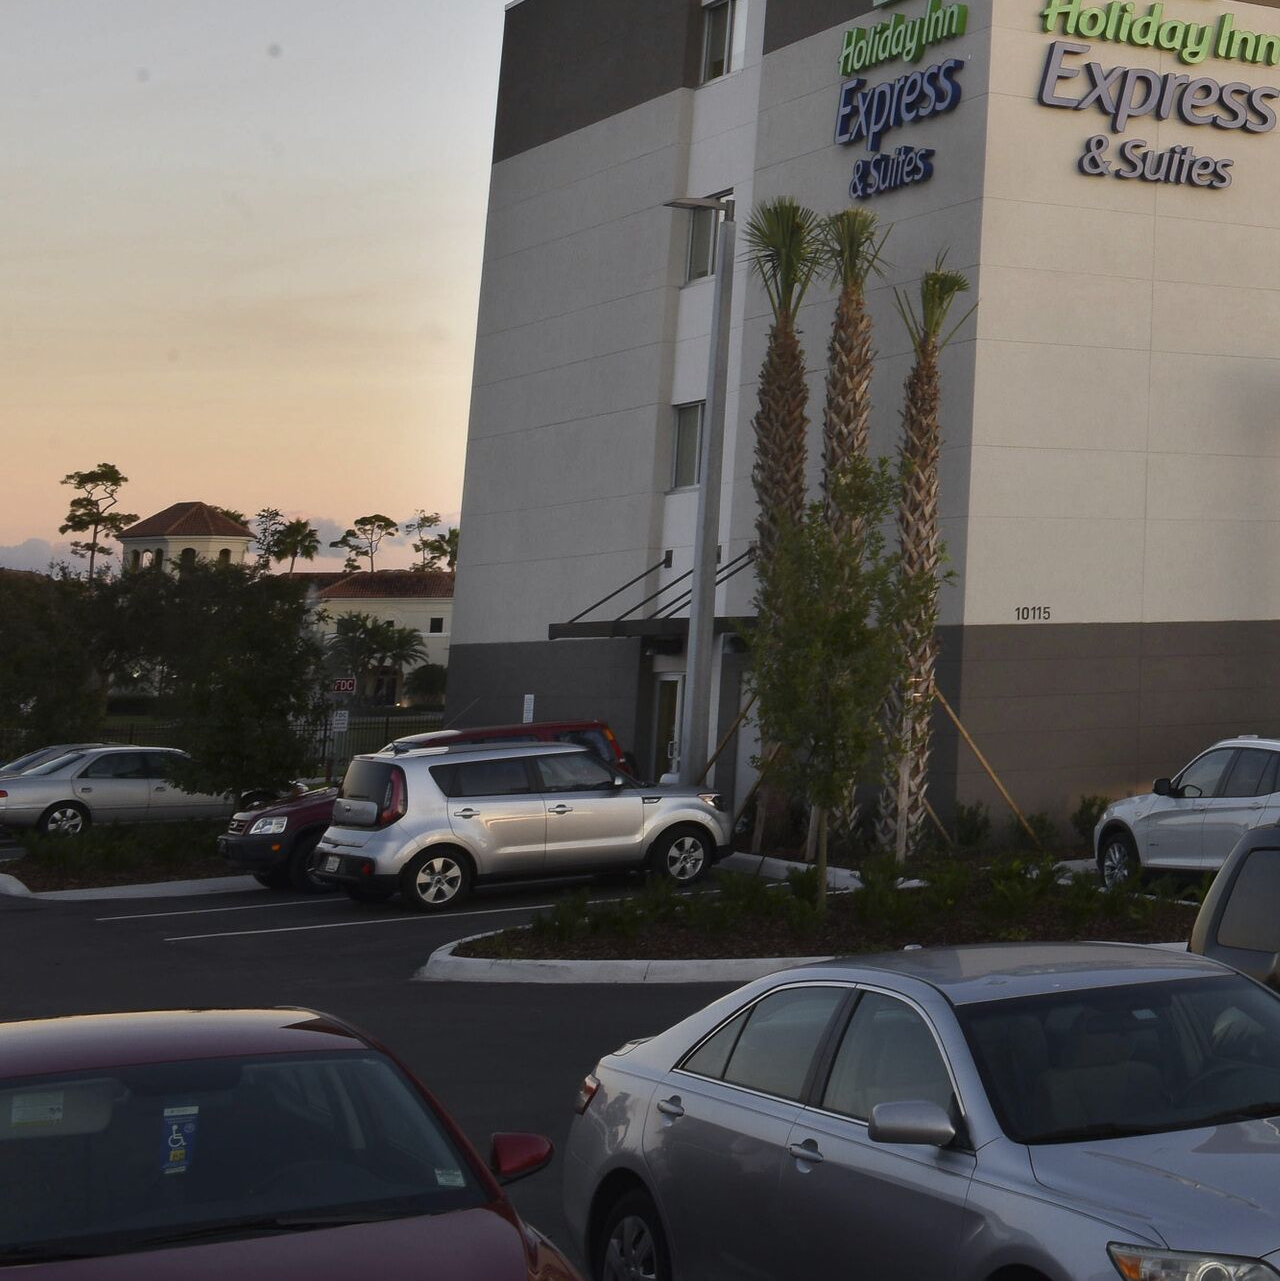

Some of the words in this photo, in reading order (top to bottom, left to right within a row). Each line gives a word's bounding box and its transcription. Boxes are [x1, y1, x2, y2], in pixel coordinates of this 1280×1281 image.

[838, 13, 925, 75] Holiday
[834, 58, 965, 151] Express
[1039, 40, 1280, 134] Express
[849, 159, 870, 199] &
[867, 145, 936, 196] Suites
[1077, 134, 1113, 177] &
[1114, 138, 1235, 189] Suites
[1014, 606, 1051, 621] 10115
